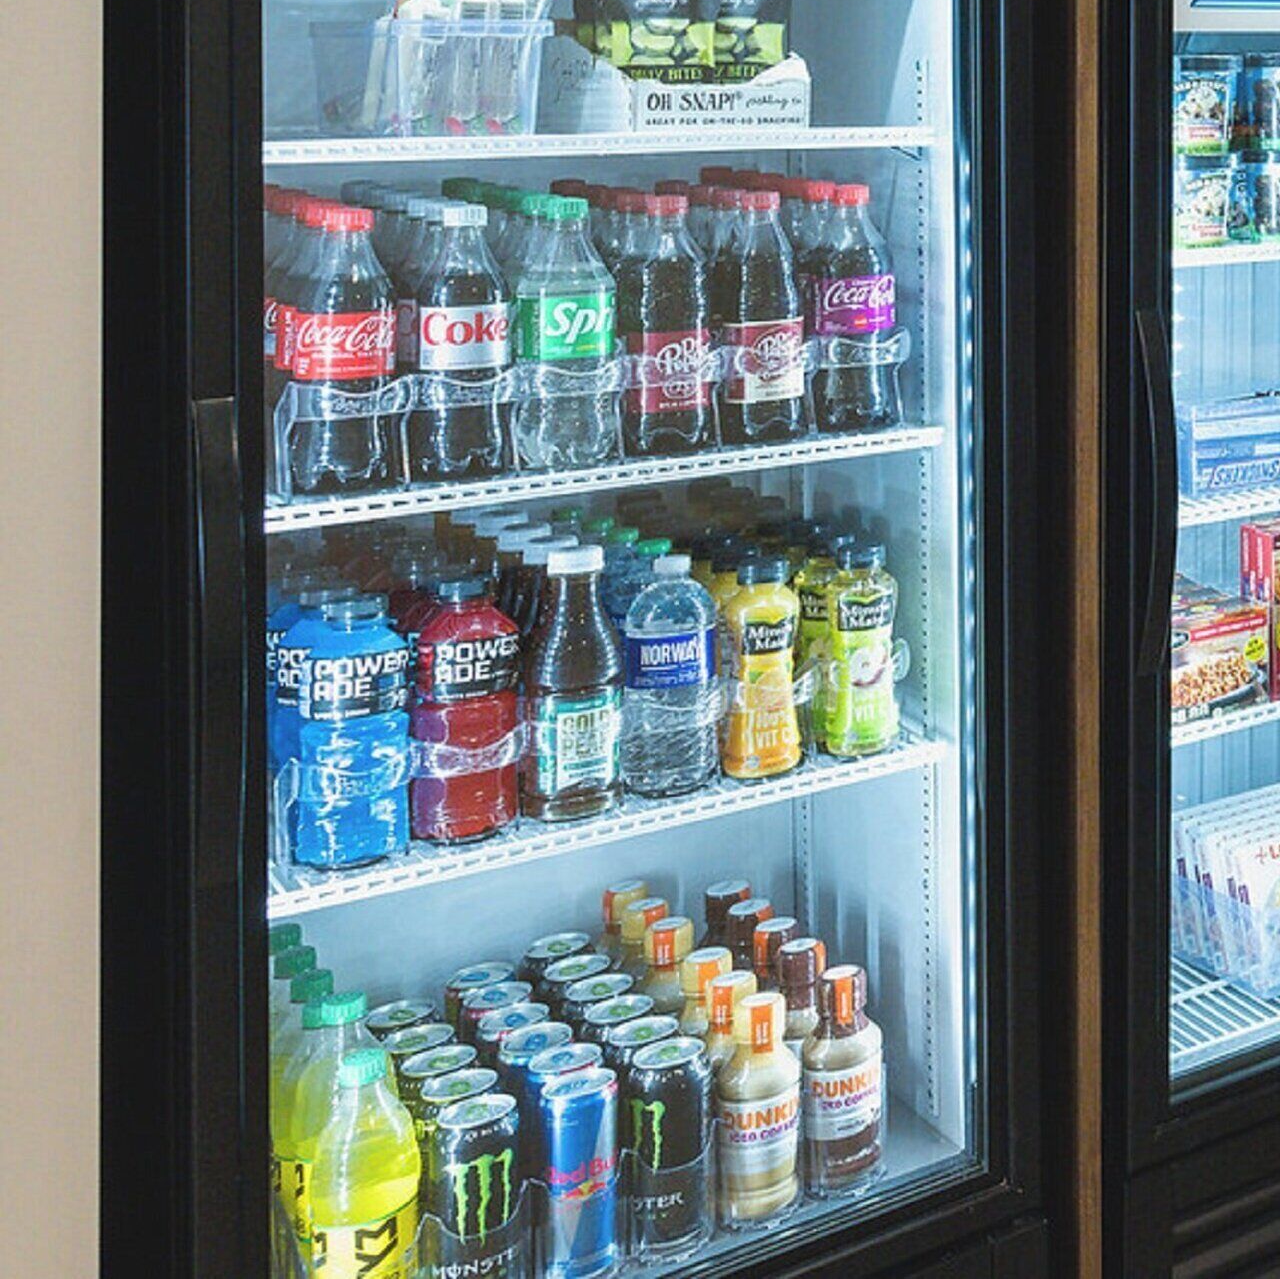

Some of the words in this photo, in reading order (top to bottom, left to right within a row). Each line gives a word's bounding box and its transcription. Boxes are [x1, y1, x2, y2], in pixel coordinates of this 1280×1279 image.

[647, 92, 673, 111] OH
[423, 311, 509, 347] Coke
[314, 649, 409, 680] POWER
[433, 662, 493, 685] ADE
[312, 679, 372, 702] ADE
[722, 1097, 799, 1131] DUNKI
[588, 1155, 617, 1177] Bu
[633, 1191, 683, 1211] STER
